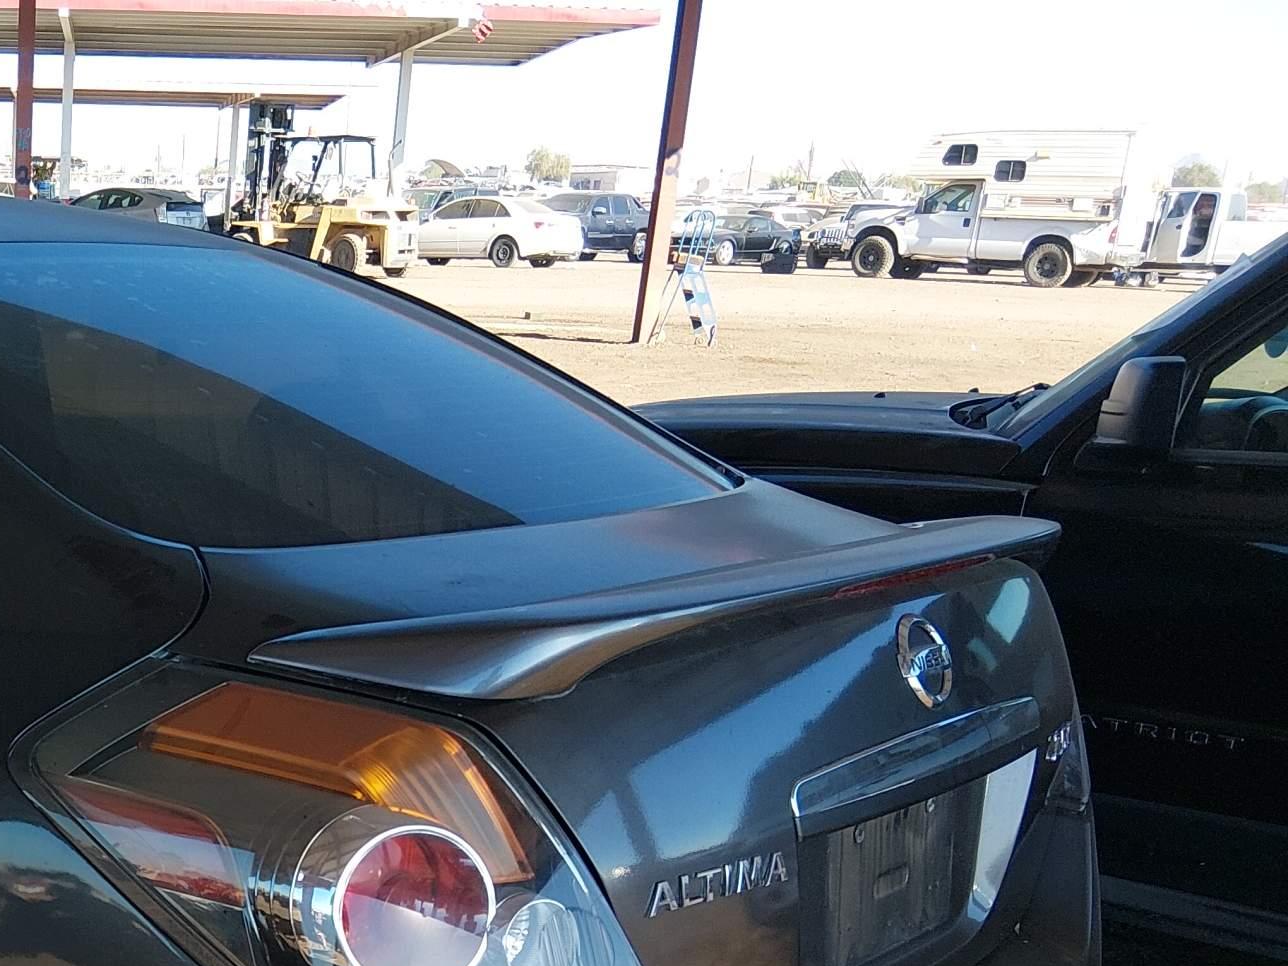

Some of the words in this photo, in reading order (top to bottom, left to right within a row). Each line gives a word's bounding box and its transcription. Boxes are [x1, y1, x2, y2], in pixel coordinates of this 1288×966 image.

[910, 649, 950, 672] NISS
[1080, 714, 1245, 750] ATRIOT
[645, 851, 789, 918] ALTIMA
